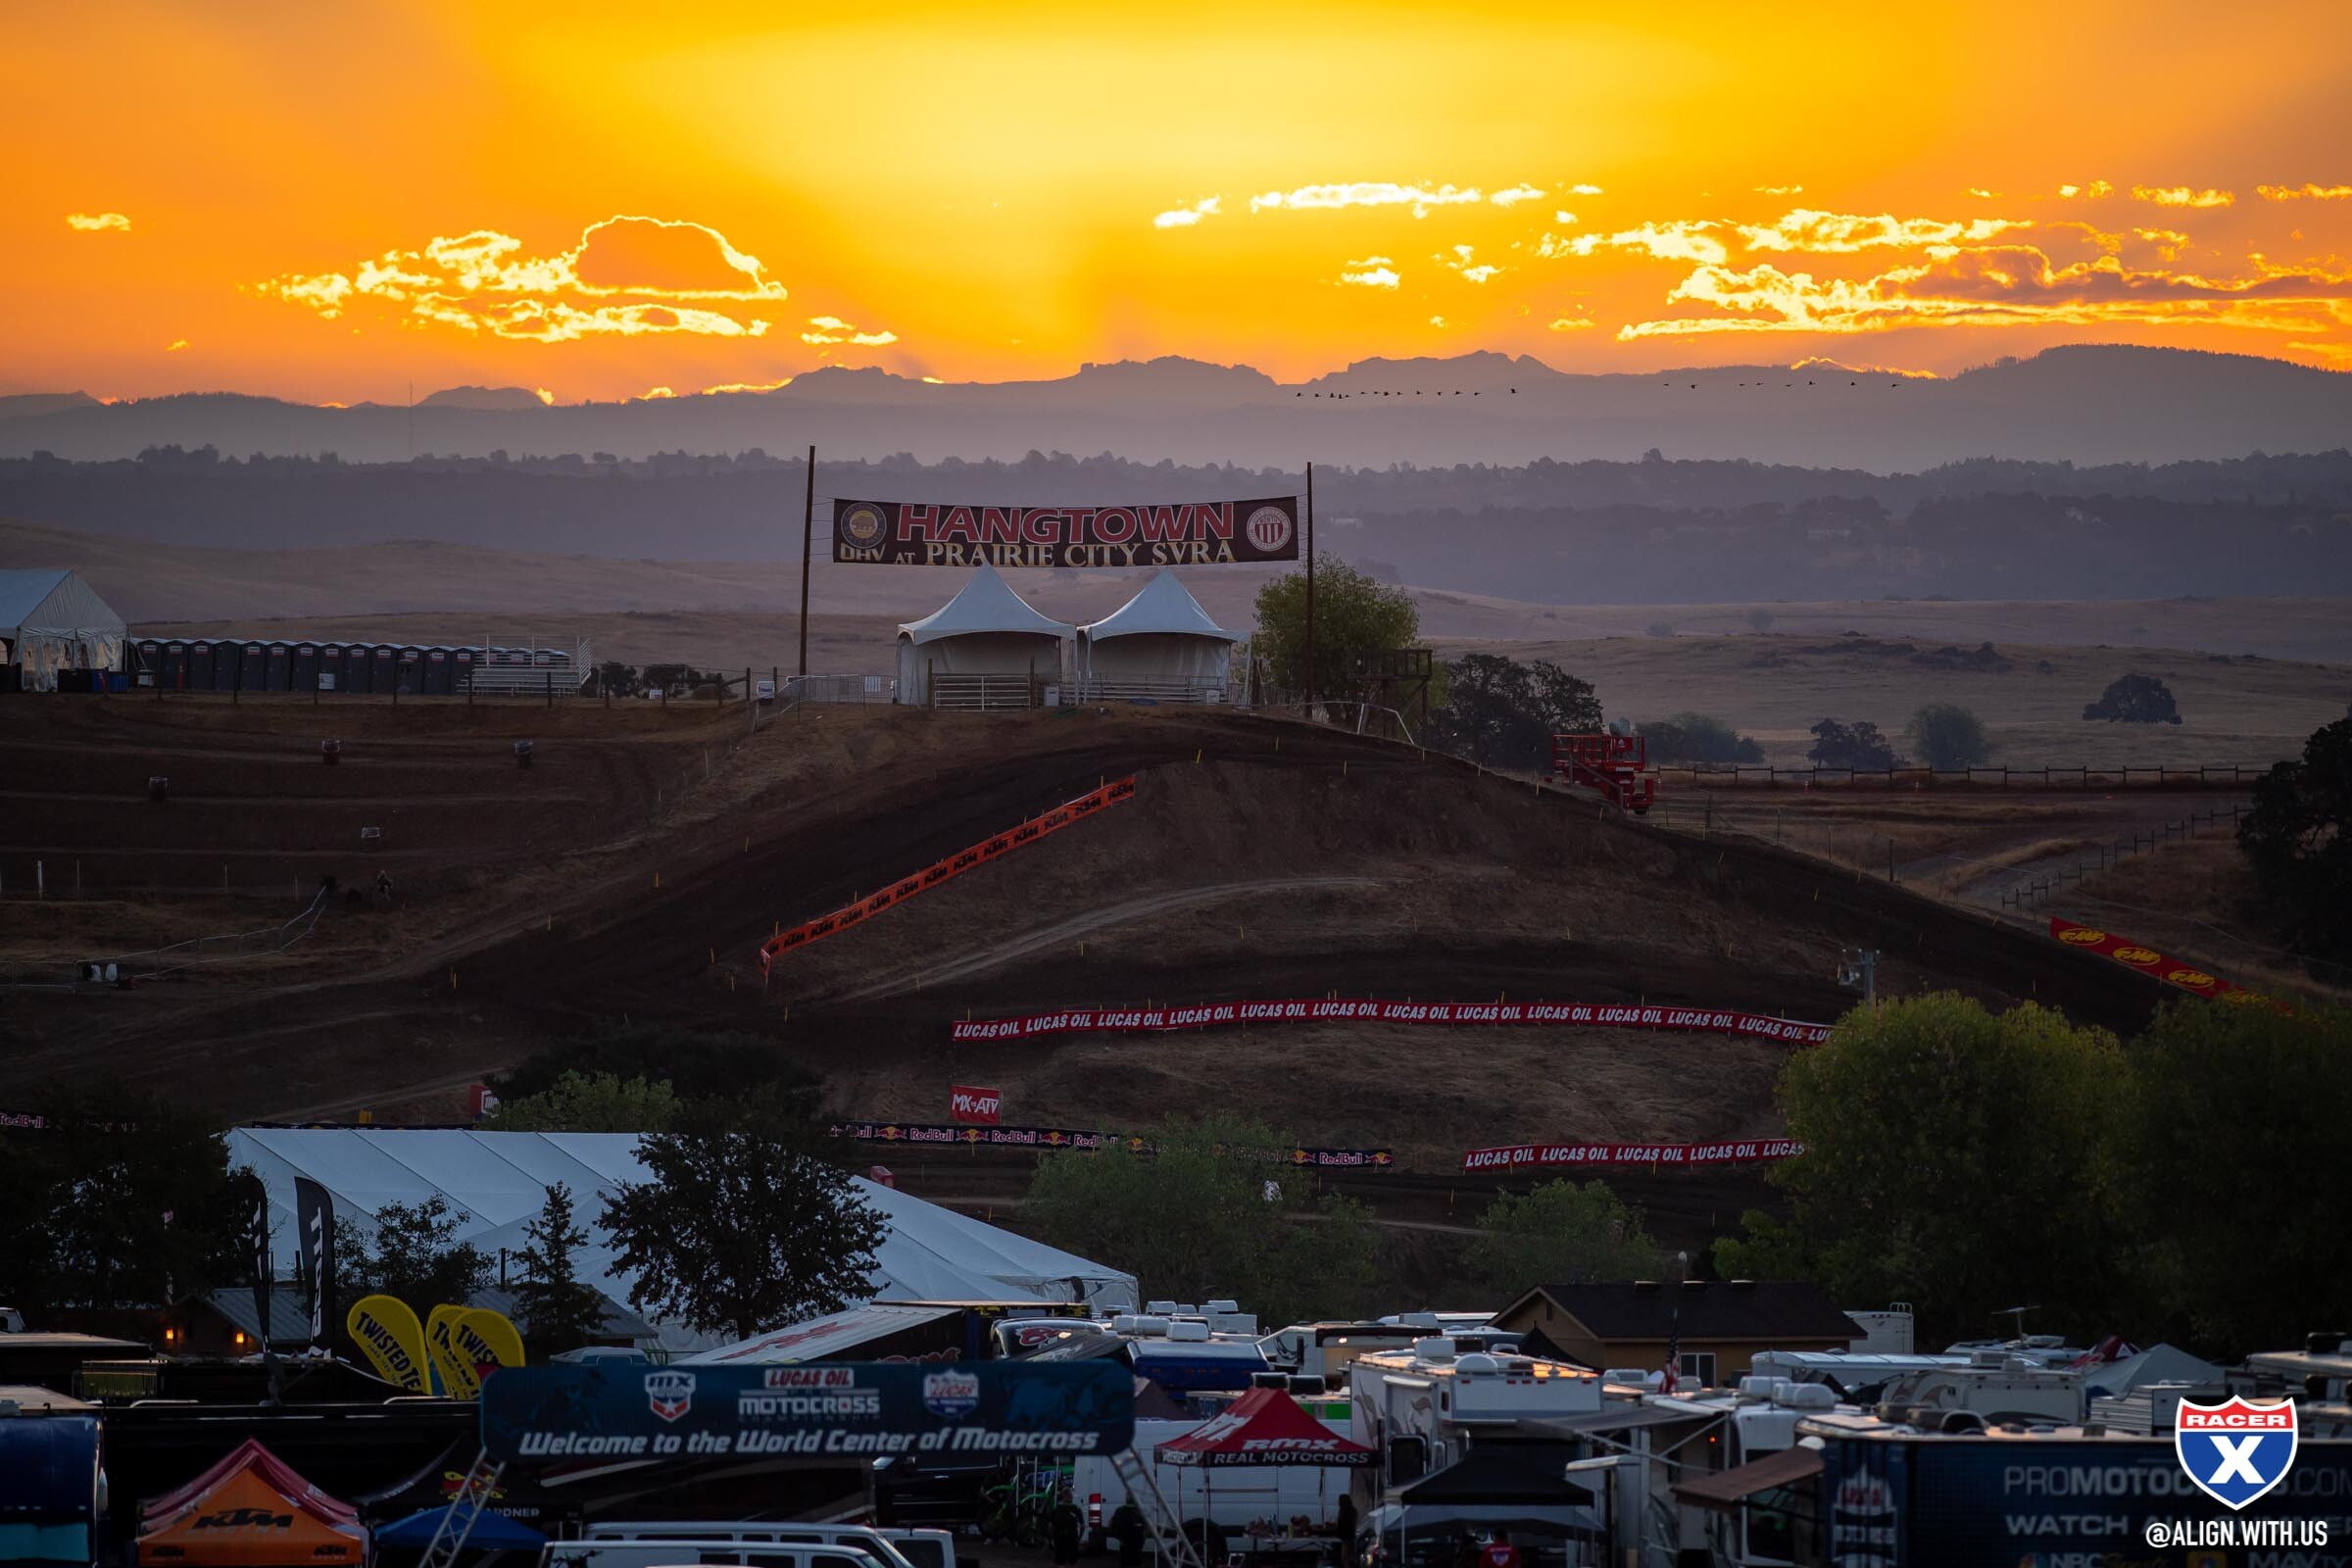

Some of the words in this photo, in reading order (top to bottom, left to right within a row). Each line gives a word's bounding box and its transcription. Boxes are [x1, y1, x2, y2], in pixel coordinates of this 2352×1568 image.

[898, 502, 1234, 544] HANGTOWN
[894, 552, 915, 565] AT
[925, 542, 1055, 567] PRAIRIE
[1064, 543, 1142, 567] CITY
[1152, 541, 1237, 565] SVRA
[954, 1024, 998, 1038] LUCAS
[999, 1021, 1019, 1035] OIL
[1025, 1014, 1068, 1032] LUCAS
[1070, 1013, 1092, 1027] OIL
[1097, 1013, 1140, 1027] LUCAS
[1143, 1012, 1163, 1026] OIL
[1169, 1008, 1211, 1024] LUCAS
[1213, 1005, 1235, 1019] OIL
[1240, 1004, 1283, 1017] LUCAS
[1285, 1003, 1306, 1016] OIL
[1312, 1003, 1354, 1016] LUCAS
[1357, 1003, 1378, 1016] OIL
[1384, 1005, 1427, 1019] LUCAS
[1429, 1006, 1450, 1019] OIL
[1455, 1006, 1498, 1020] LUCAS
[1500, 1006, 1521, 1020] OIL
[1527, 1006, 1569, 1020] LUCAS
[1571, 1006, 1592, 1020] OIL
[1597, 1008, 1640, 1023] LUCAS
[1642, 1009, 1662, 1023] OIL
[1667, 1011, 1710, 1026] LUCAS
[1712, 1013, 1734, 1028] OIL
[1738, 1016, 1782, 1036] LUCAS
[1782, 1026, 1804, 1040] OIL
[952, 1094, 972, 1112] MX
[973, 1097, 999, 1114] ATV
[1466, 1151, 1510, 1167] LUCAS
[1512, 1149, 1535, 1163] OIL
[1541, 1147, 1585, 1161] LUCAS
[1588, 1147, 1609, 1160] OIL
[1615, 1148, 1659, 1161] LUCAS
[1662, 1148, 1684, 1161] OIL
[1690, 1146, 1734, 1160] LUCAS
[1736, 1144, 1757, 1157] OIL
[356, 1311, 411, 1375] TWISTED
[768, 1371, 821, 1386] LUCAS
[824, 1371, 852, 1386] OIL
[738, 1396, 880, 1415] MOTOCROSS
[518, 1432, 647, 1455] Welcome
[653, 1433, 681, 1454] to
[687, 1430, 731, 1453] the
[735, 1429, 823, 1454] World
[826, 1429, 916, 1452] Center
[919, 1427, 953, 1450] of
[952, 1427, 1100, 1450] Motocross
[1214, 1452, 1257, 1464] REAL
[1262, 1452, 1370, 1464] MOTOCROSS
[192, 1508, 293, 1529] KTM
[2004, 1514, 2130, 1537] WATCH
